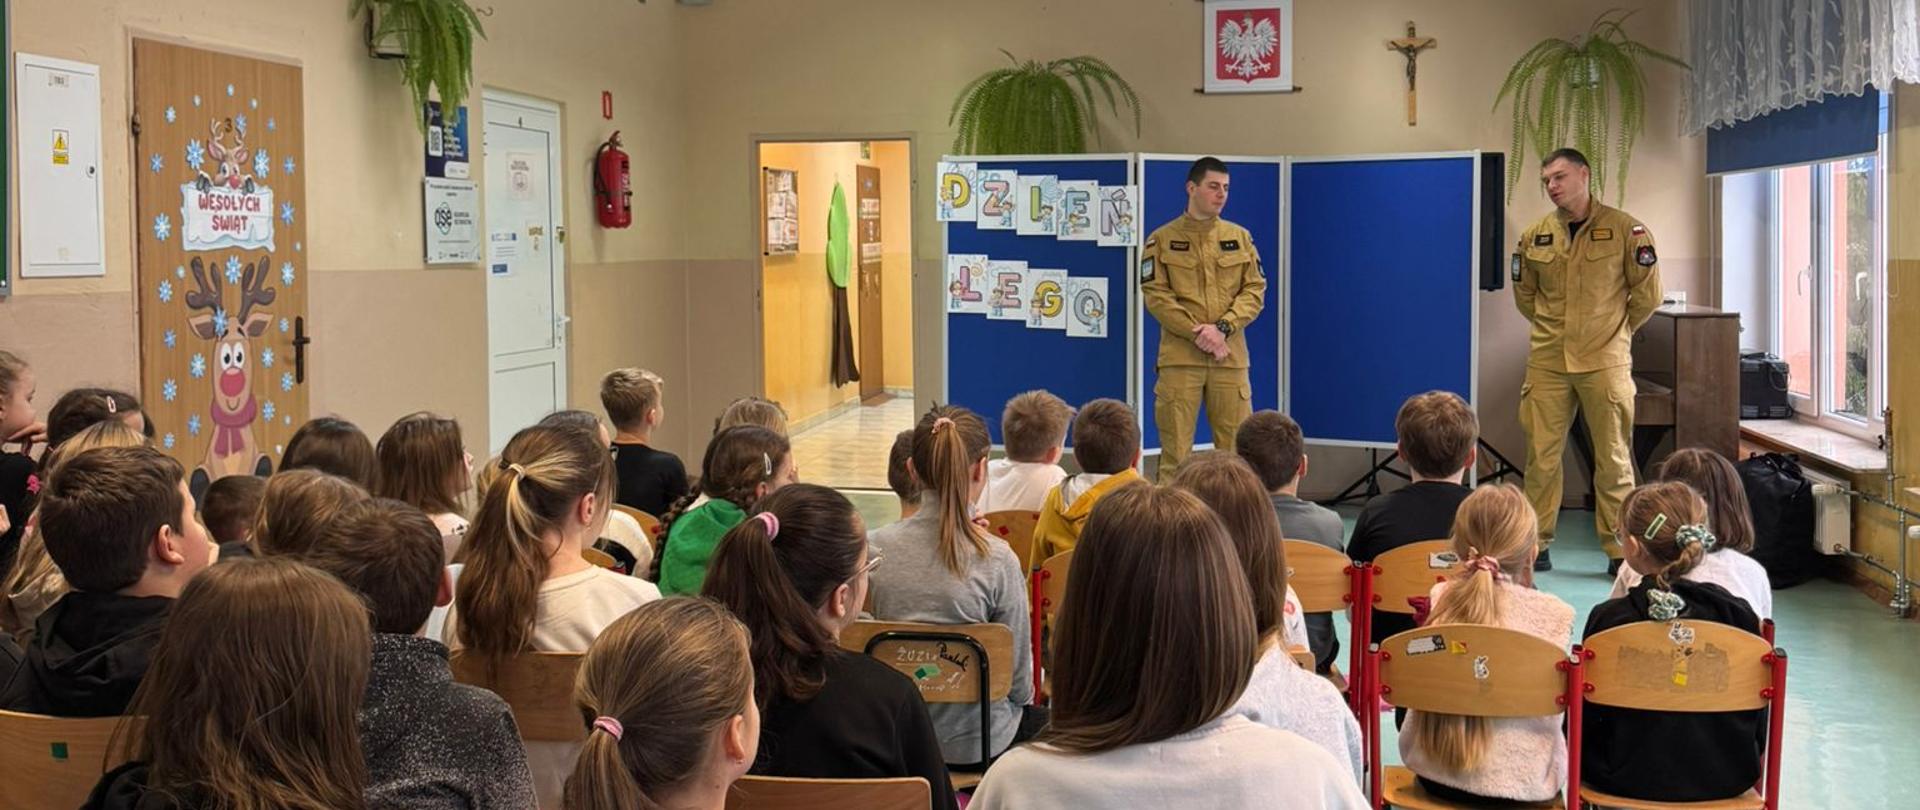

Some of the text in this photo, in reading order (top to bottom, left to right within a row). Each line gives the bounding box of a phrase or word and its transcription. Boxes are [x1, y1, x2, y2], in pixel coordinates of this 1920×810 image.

[224, 118, 232, 132] 3
[943, 173, 1131, 237] DZIEŃ
[959, 266, 1105, 327] LEGO
